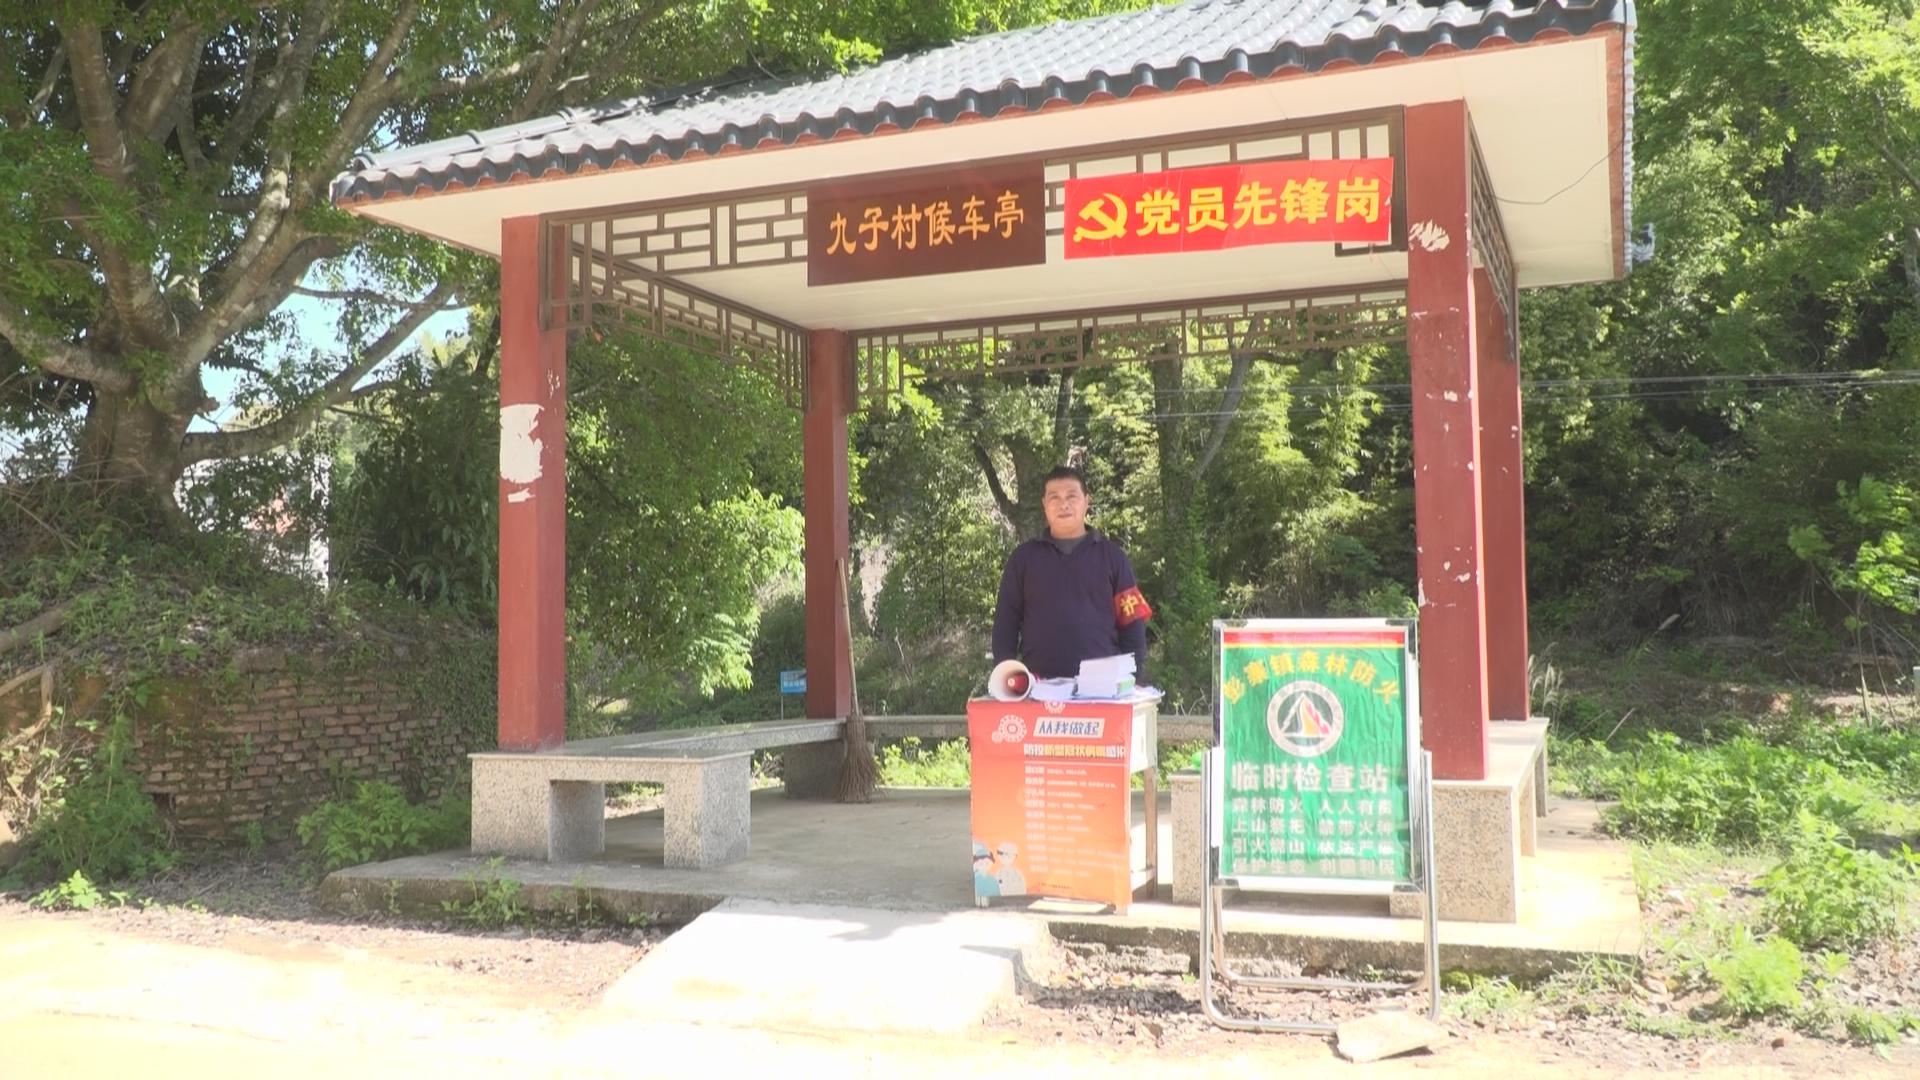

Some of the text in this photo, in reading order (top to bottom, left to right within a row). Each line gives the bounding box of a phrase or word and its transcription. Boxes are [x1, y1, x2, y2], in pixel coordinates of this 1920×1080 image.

[827, 189, 1024, 255] 九子村候车亭
[1134, 176, 1380, 237] 党员先锋岗
[1038, 719, 1100, 736] 从我做起
[1231, 761, 1389, 794] 临时检查站
[1231, 797, 1303, 814] 森林防火
